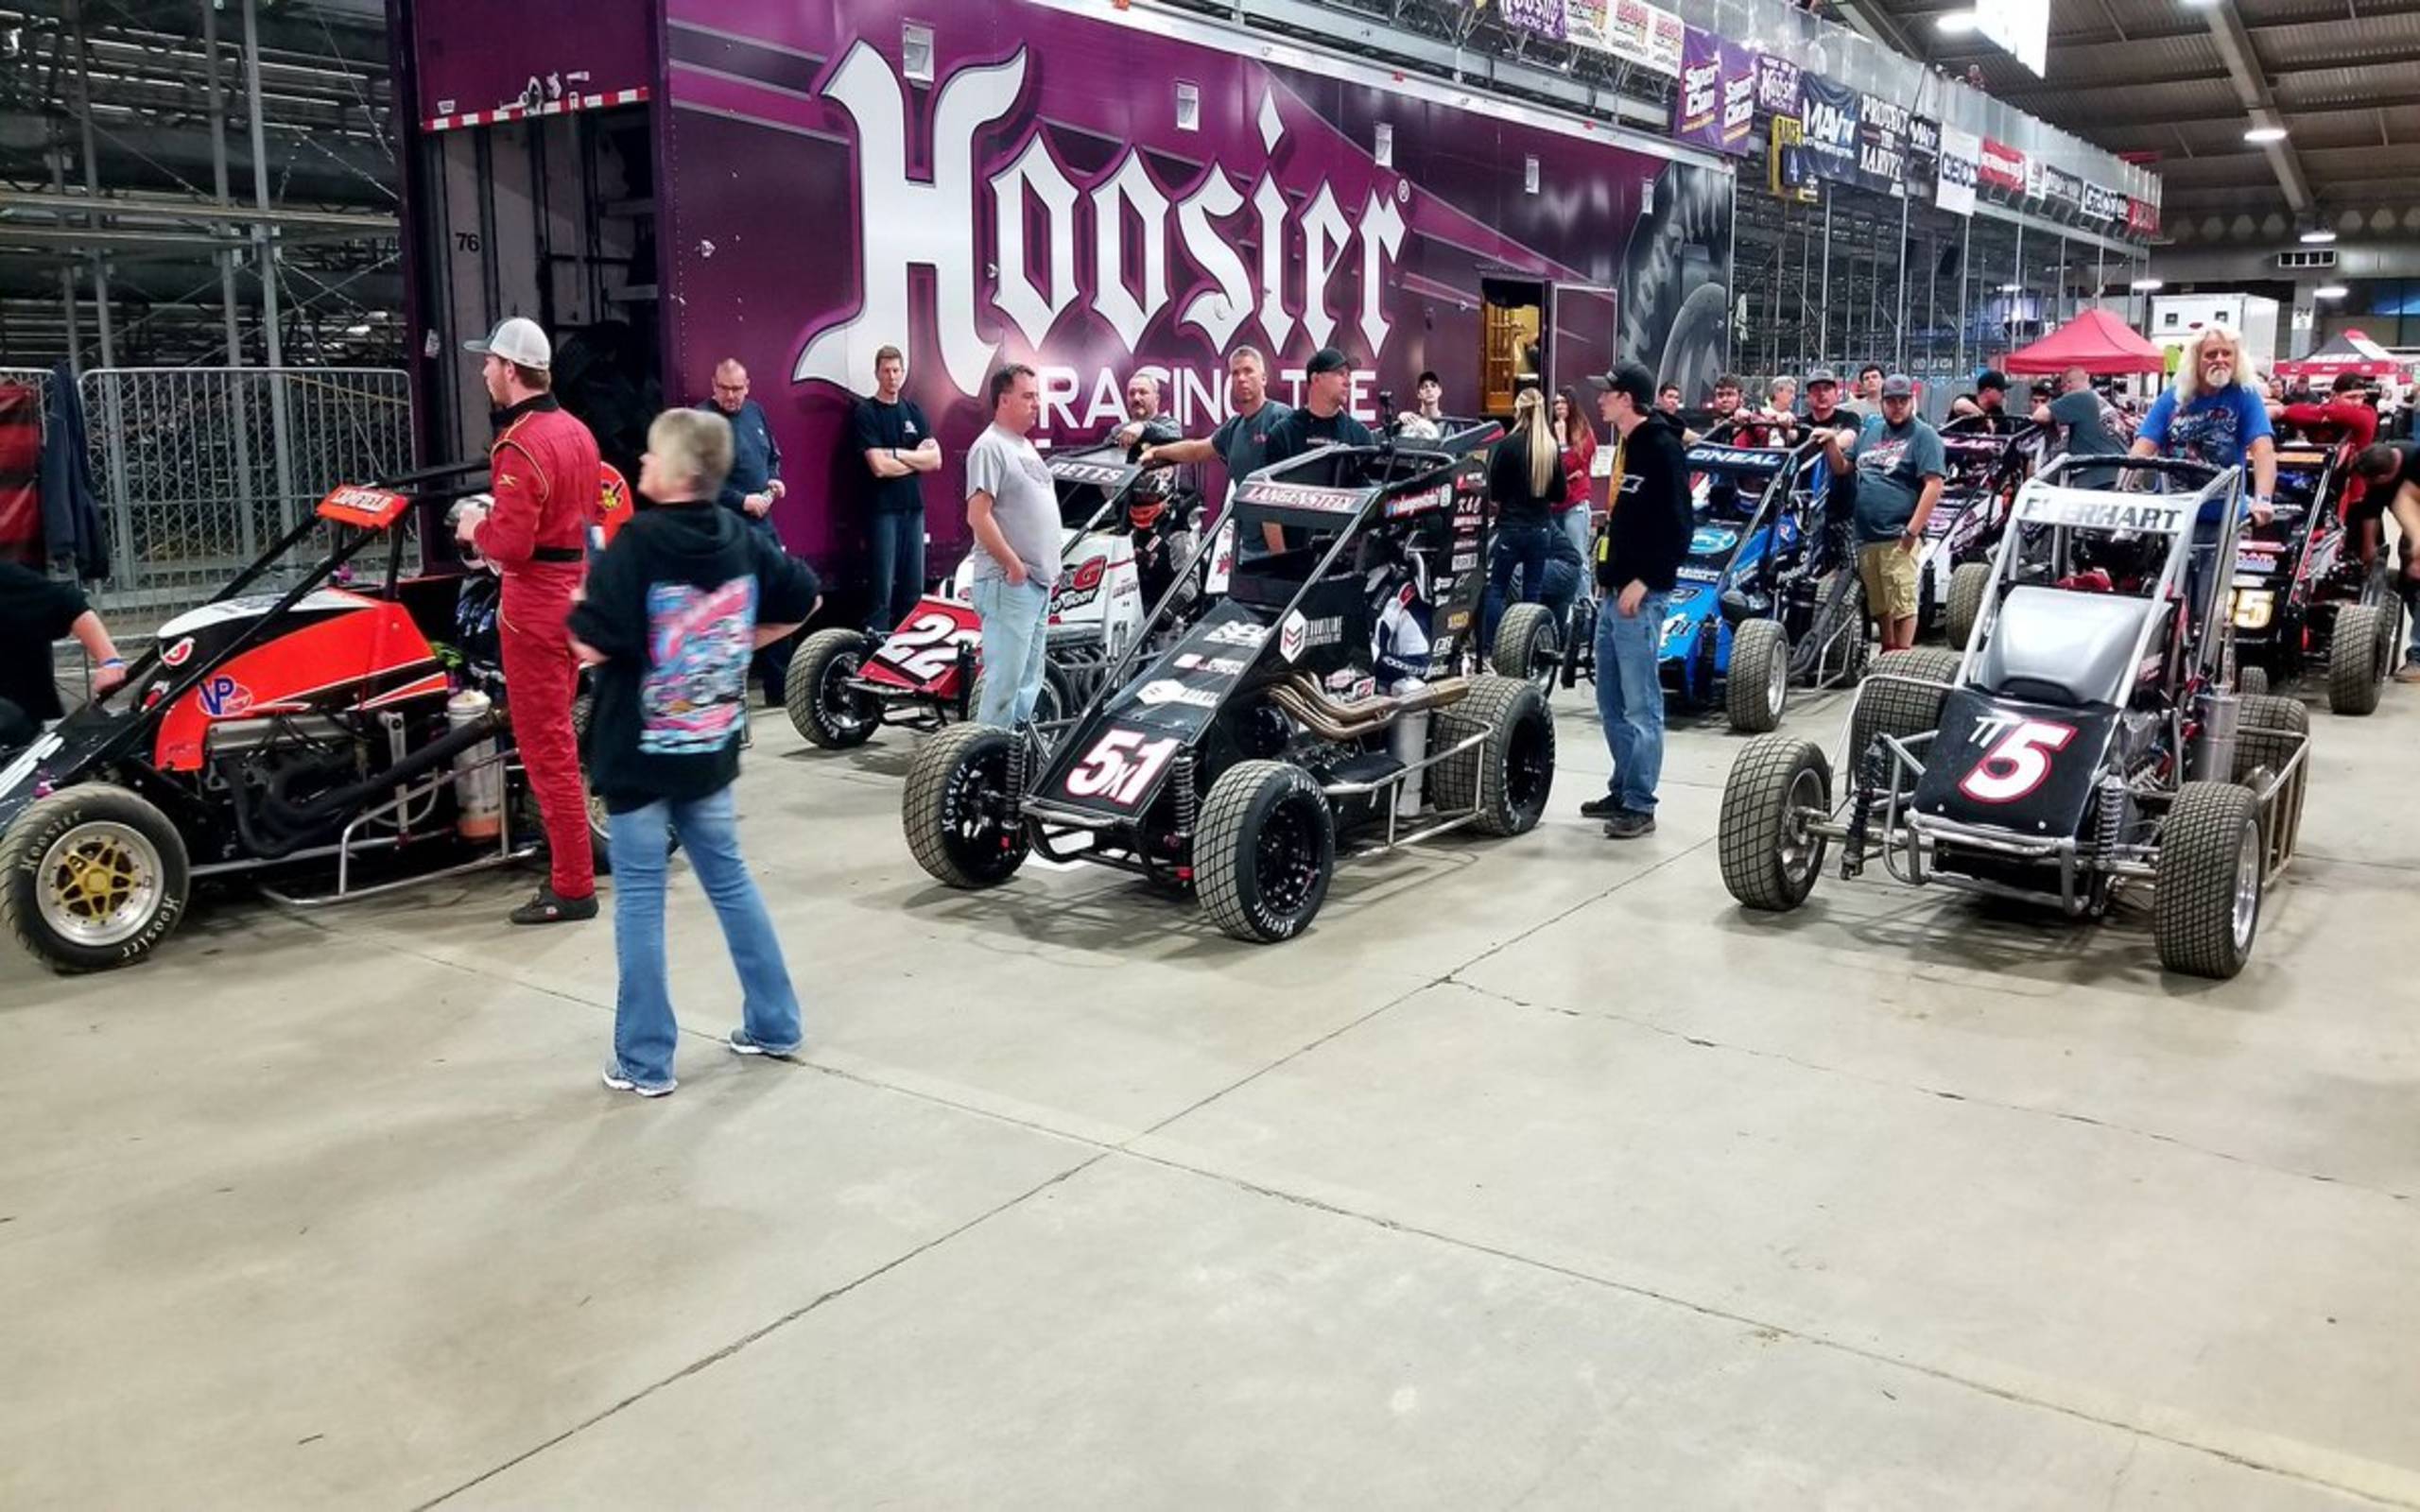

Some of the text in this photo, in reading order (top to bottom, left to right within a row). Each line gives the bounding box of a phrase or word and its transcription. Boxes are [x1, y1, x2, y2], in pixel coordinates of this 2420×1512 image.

[455, 232, 480, 252] 76
[2021, 497, 2182, 531] EERHART
[199, 676, 235, 716] VP
[1958, 718, 2079, 806] 5
